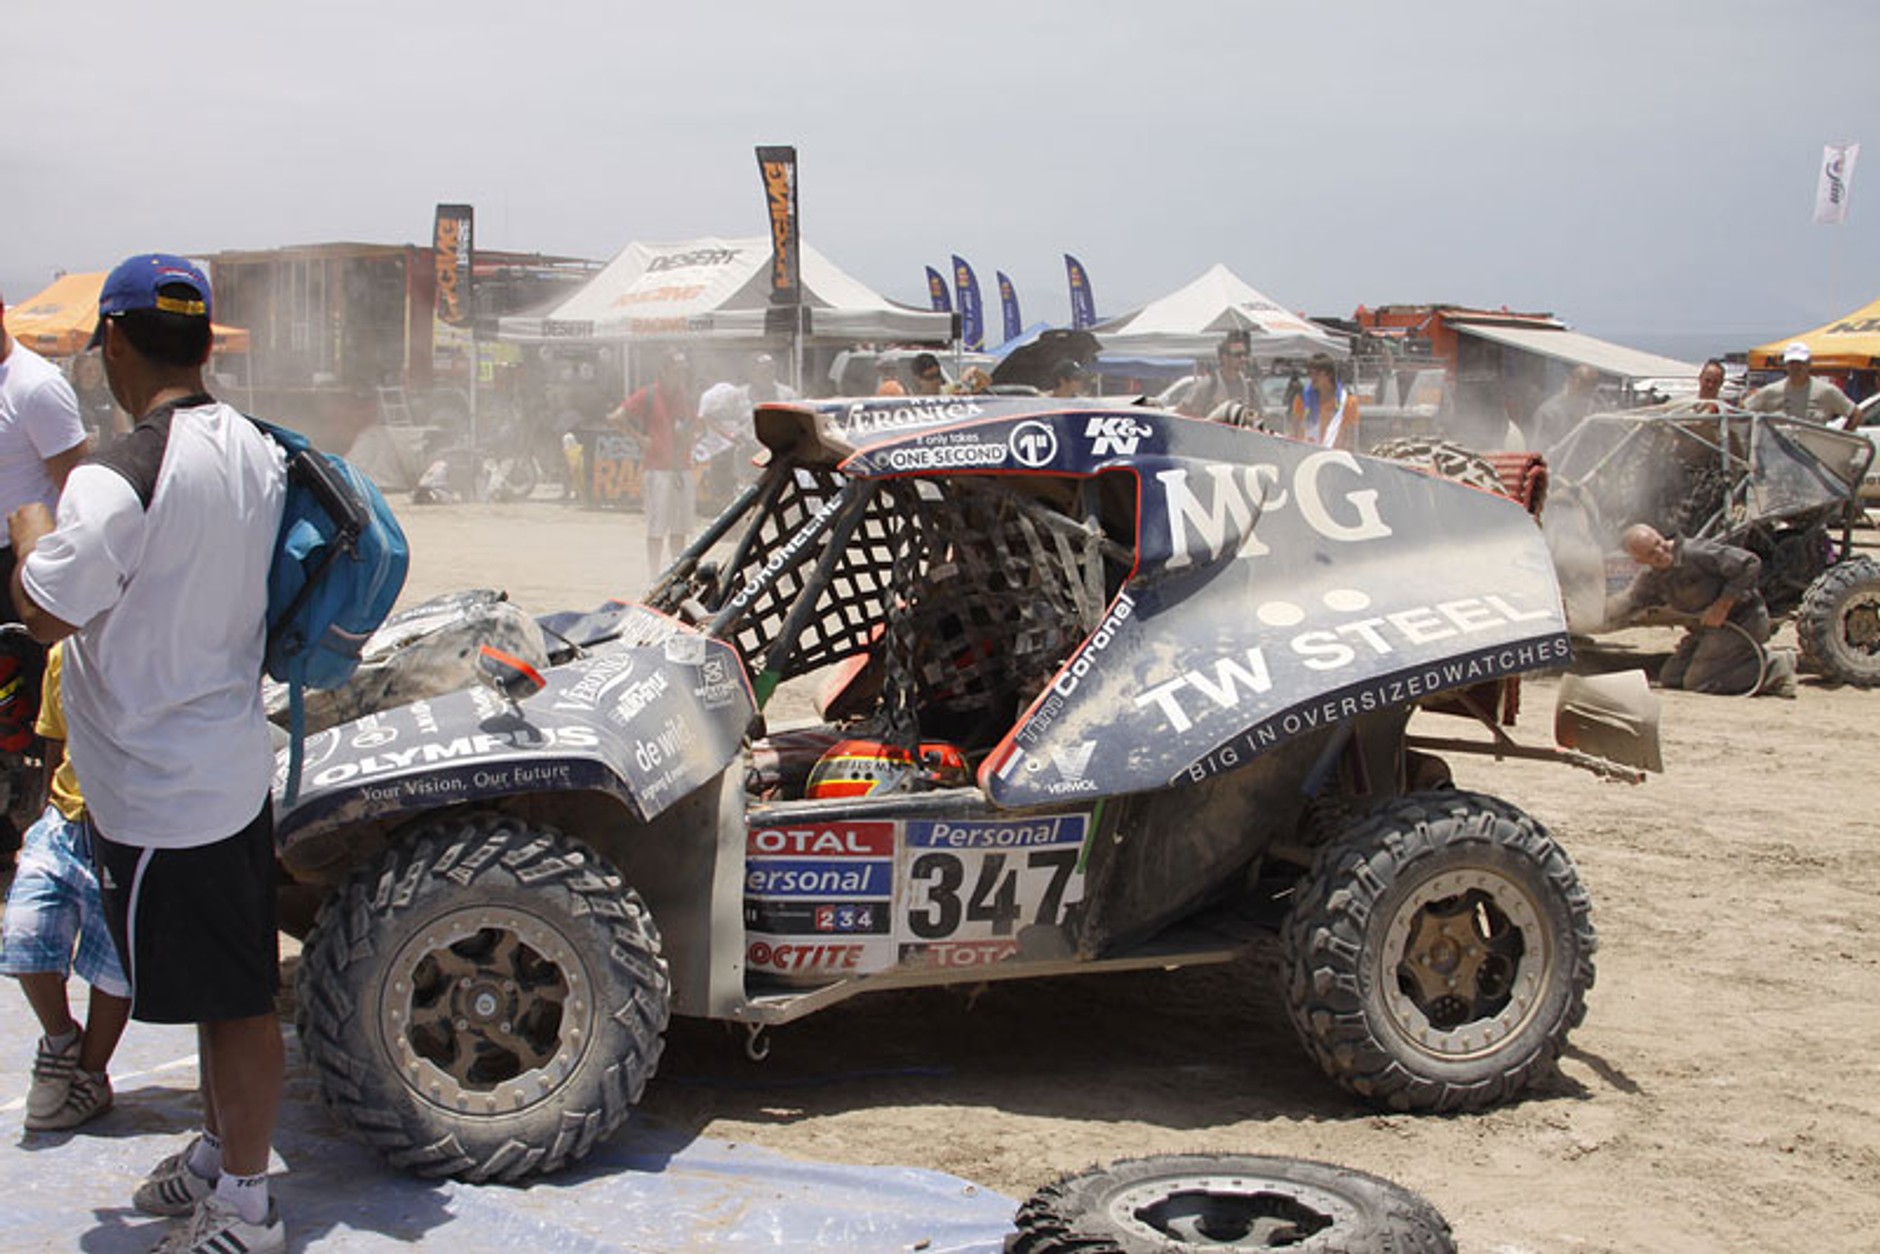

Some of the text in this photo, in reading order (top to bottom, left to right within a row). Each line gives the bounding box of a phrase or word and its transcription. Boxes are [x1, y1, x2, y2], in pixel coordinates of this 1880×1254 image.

[649, 249, 743, 272] DESERT
[541, 319, 595, 337] DESERT
[822, 402, 984, 439] VERONICA
[893, 448, 1003, 467] ONE SECOND
[1054, 589, 1136, 697] Coronel
[1135, 594, 1552, 735] TW STEEL
[313, 726, 599, 786] OLYMPUS
[636, 739, 661, 772] de
[1189, 747, 1239, 783] BIG
[1247, 725, 1277, 752] IN
[361, 764, 570, 802] Your Vision, Our Future
[756, 830, 872, 852] OTAL
[929, 818, 1062, 847] Personal
[748, 864, 873, 892] ersonal
[908, 848, 1080, 940] 347
[750, 941, 866, 970] OCTITE
